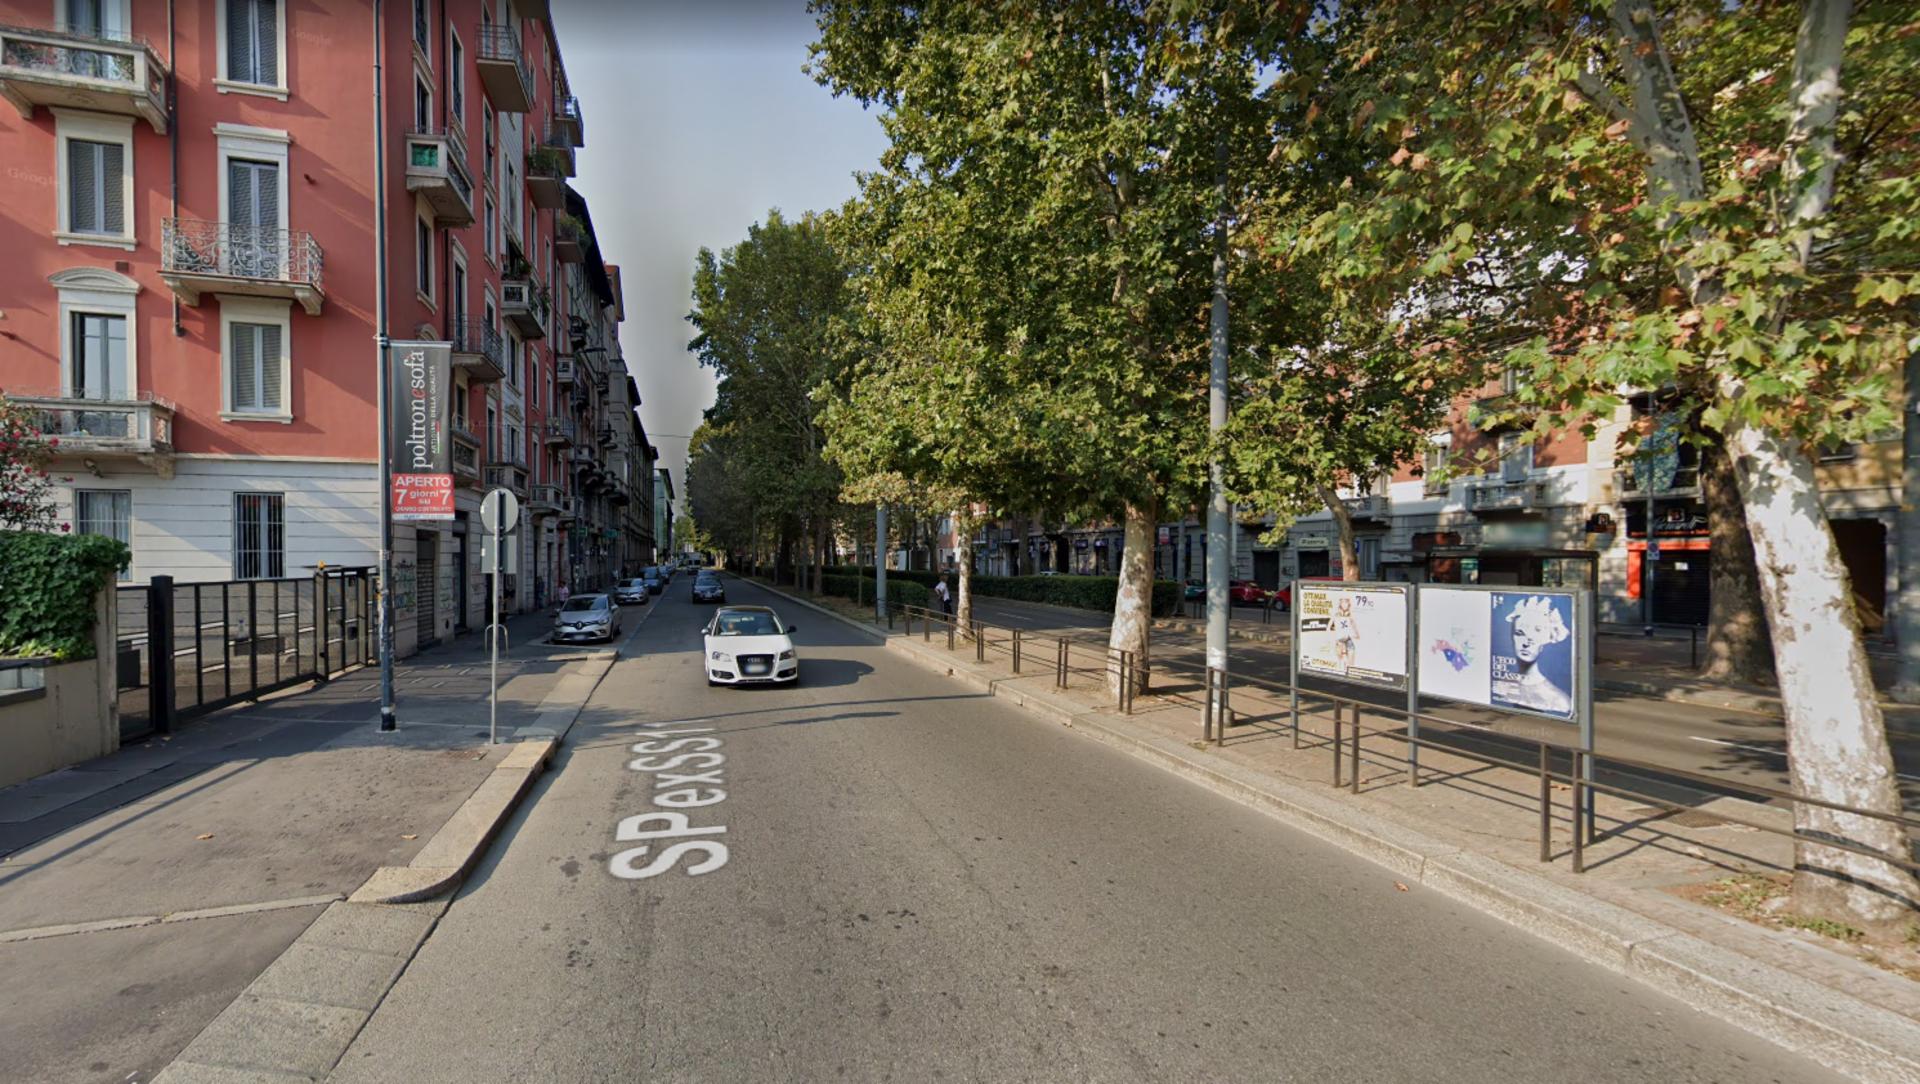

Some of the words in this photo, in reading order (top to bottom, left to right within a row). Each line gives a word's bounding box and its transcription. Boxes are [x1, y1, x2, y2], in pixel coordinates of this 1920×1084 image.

[395, 476, 452, 487] APERTO
[394, 489, 407, 505] 7
[409, 489, 439, 499] giorni
[439, 489, 452, 506] 7
[1492, 671, 1531, 681] CLASSI
